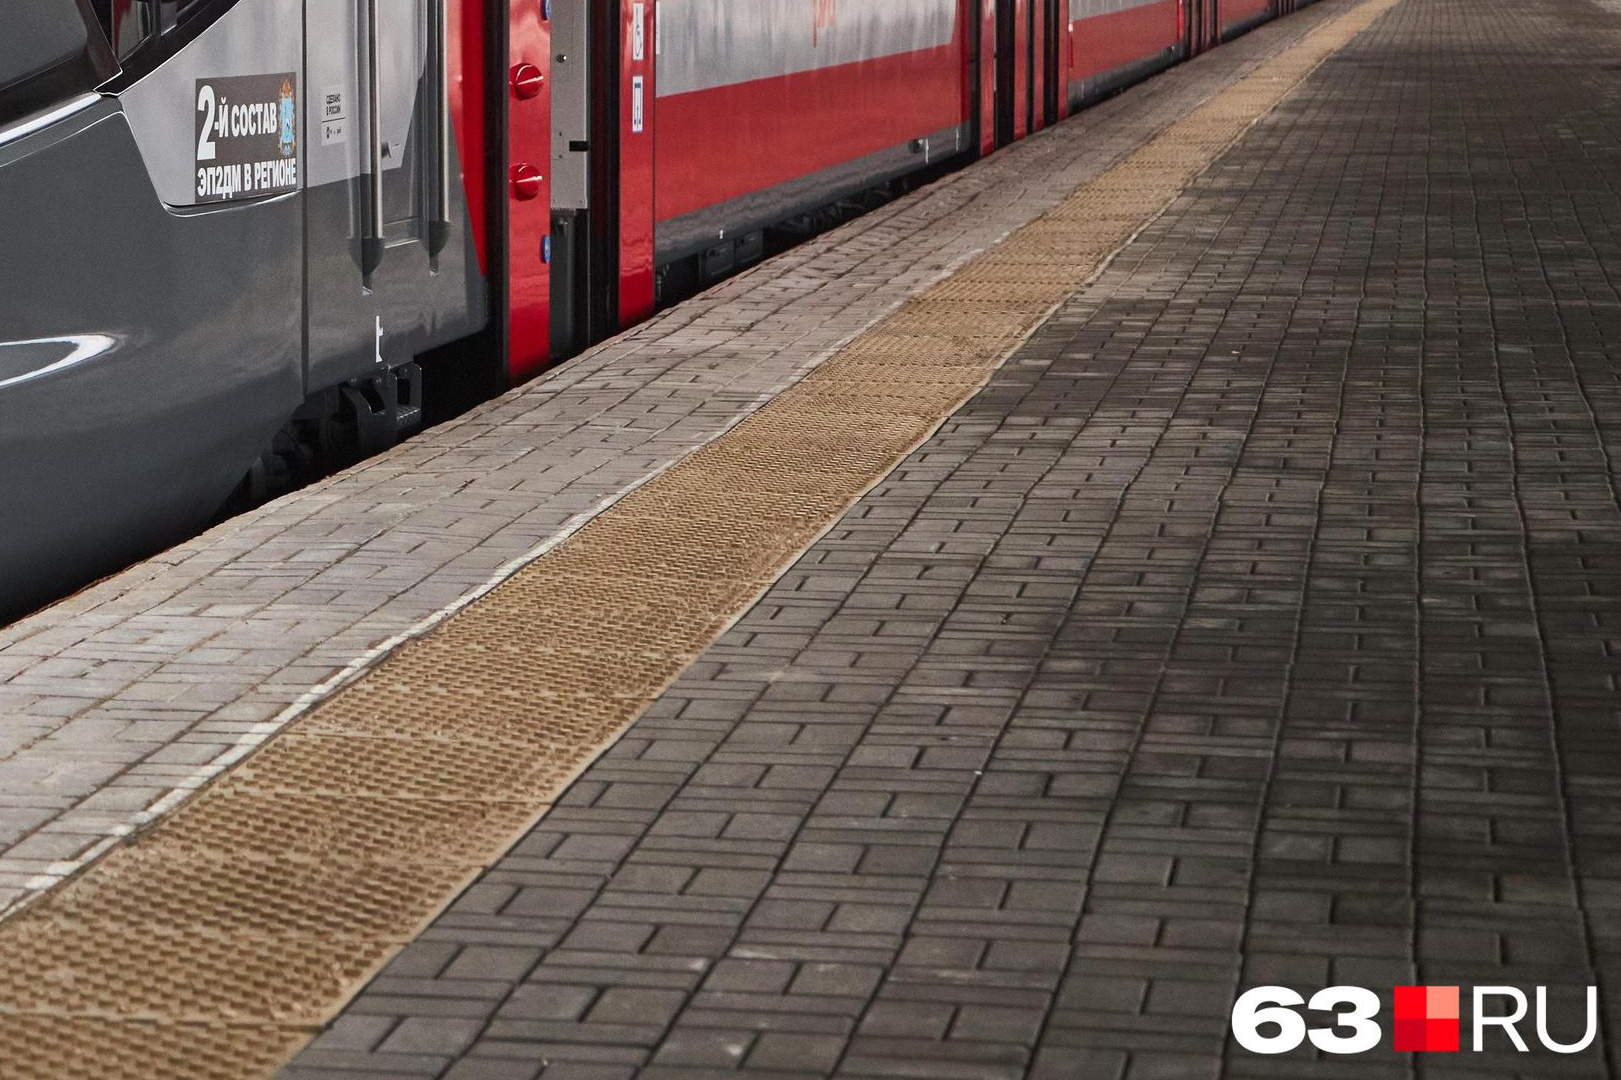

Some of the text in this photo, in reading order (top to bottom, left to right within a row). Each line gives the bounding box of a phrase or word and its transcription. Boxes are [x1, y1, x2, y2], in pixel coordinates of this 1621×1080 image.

[231, 103, 277, 137] СОСТАВ
[197, 158, 297, 199] ЭП2ДМ В РЕГИОНЕ
